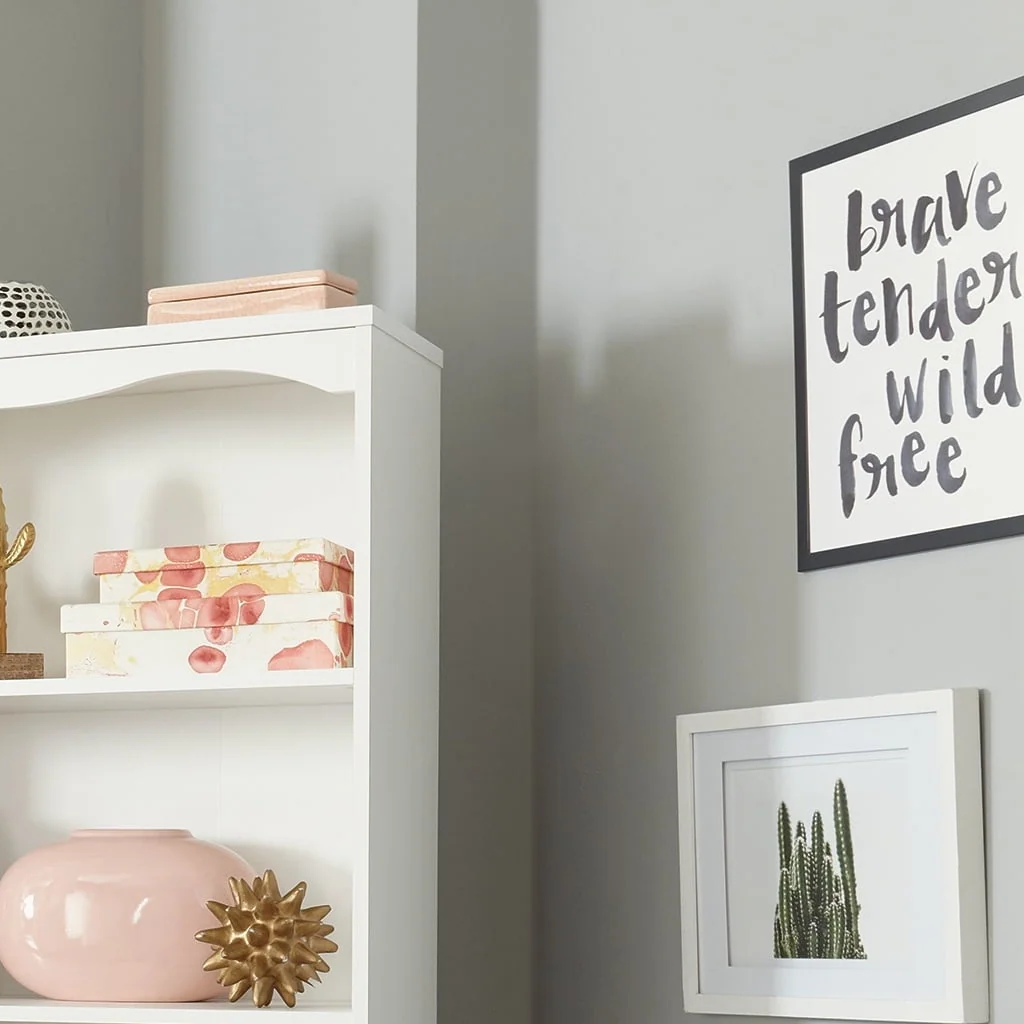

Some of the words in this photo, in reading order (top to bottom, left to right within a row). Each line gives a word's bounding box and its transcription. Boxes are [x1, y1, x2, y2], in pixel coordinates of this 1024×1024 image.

[847, 162, 1008, 272] brave
[819, 252, 1023, 364] tender
[887, 322, 1023, 426] wild
[838, 414, 967, 520] free
